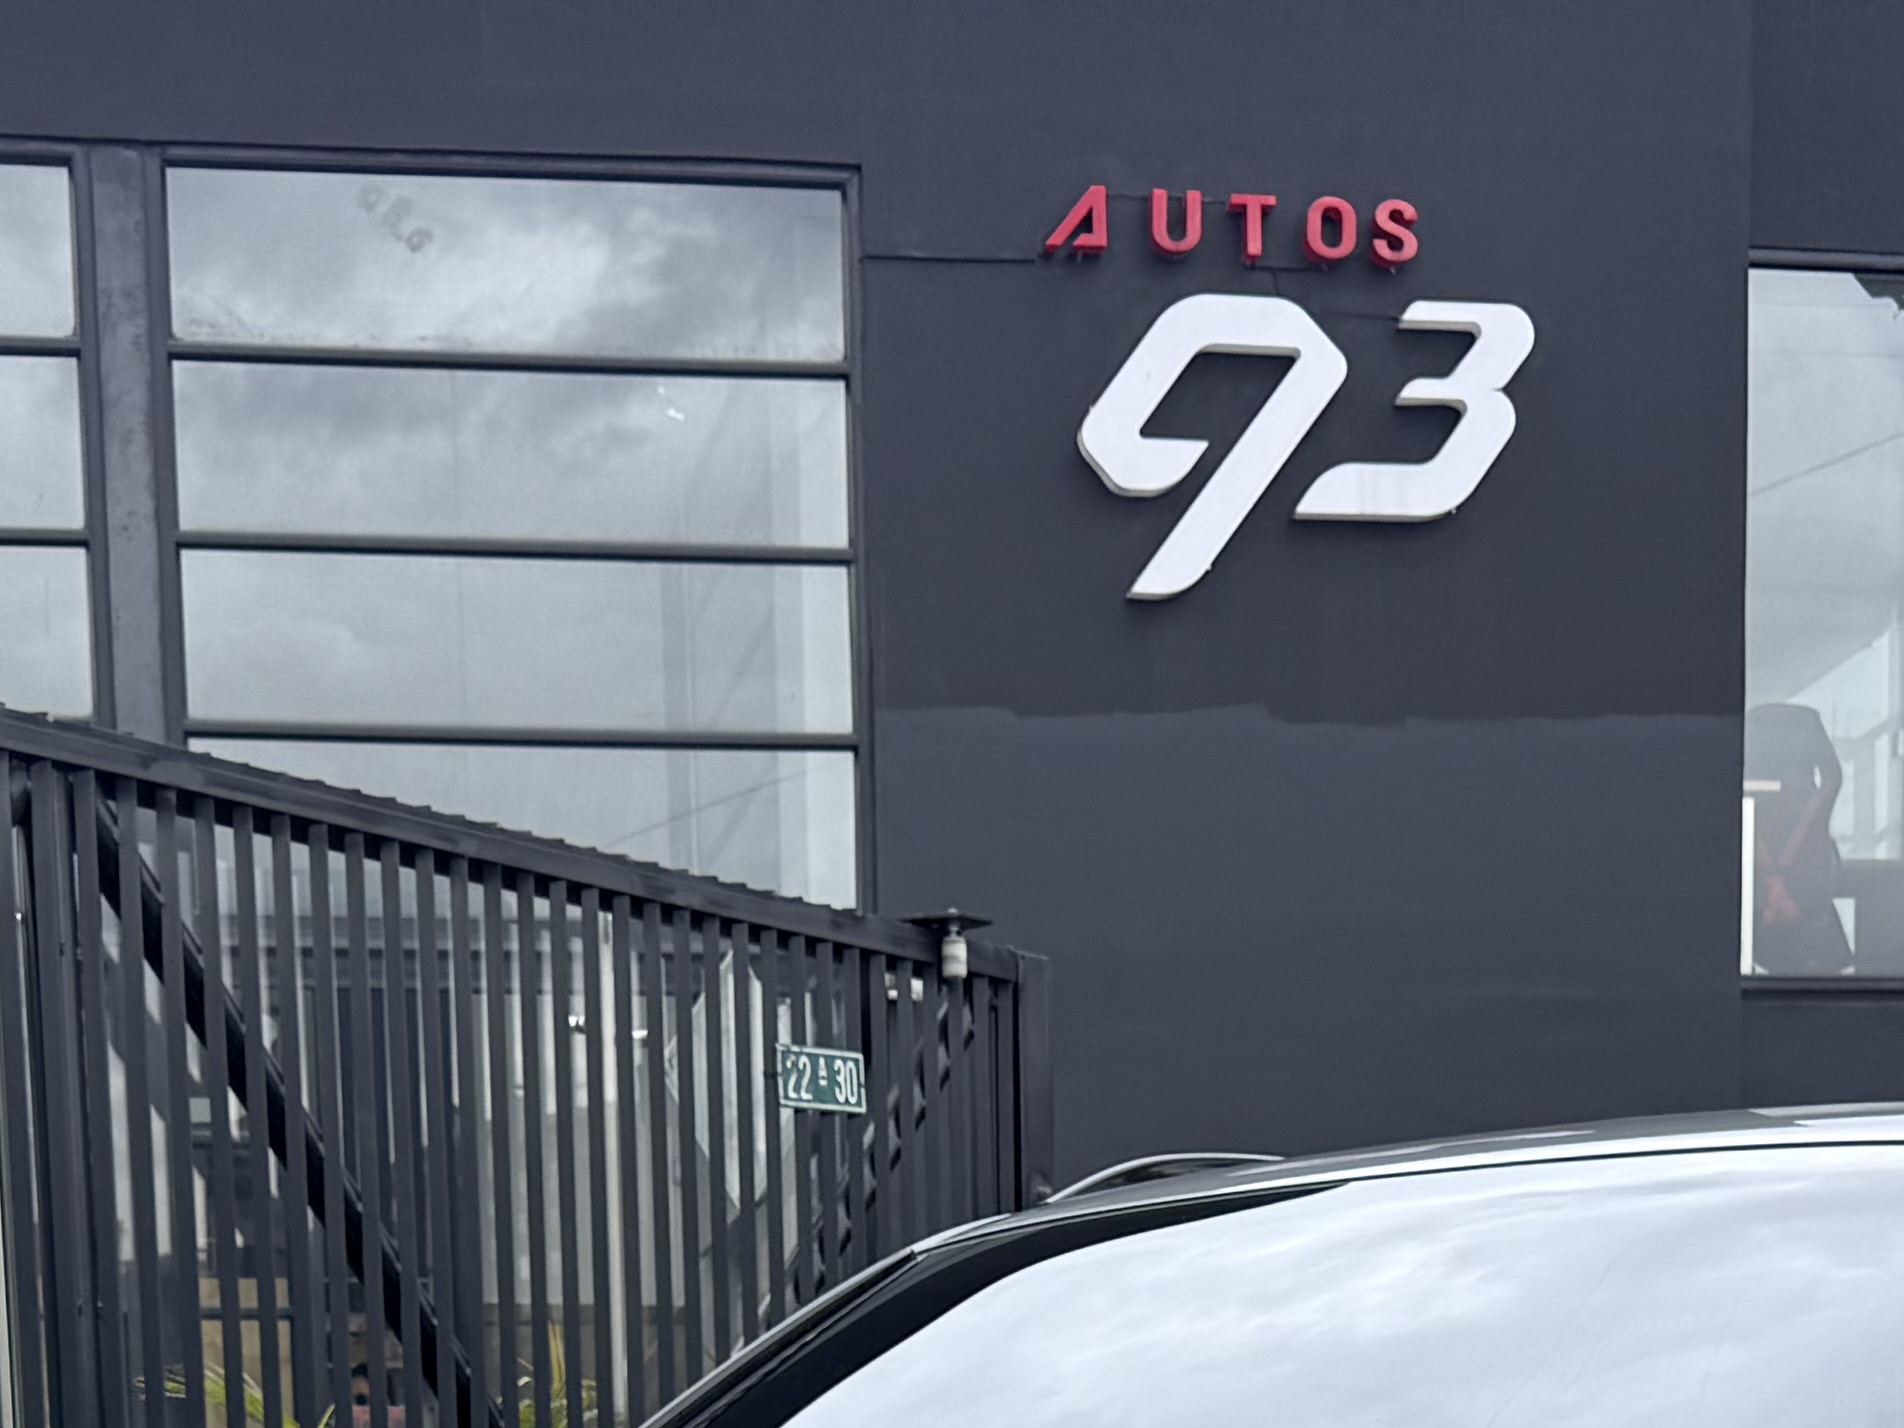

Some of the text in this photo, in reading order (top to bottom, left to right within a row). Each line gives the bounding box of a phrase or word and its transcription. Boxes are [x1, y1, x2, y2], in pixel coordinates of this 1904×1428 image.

[1042, 184, 1421, 266] AUTOS
[1075, 292, 1536, 601] 93
[785, 1054, 813, 1101] 22
[833, 1058, 858, 1105] 30
